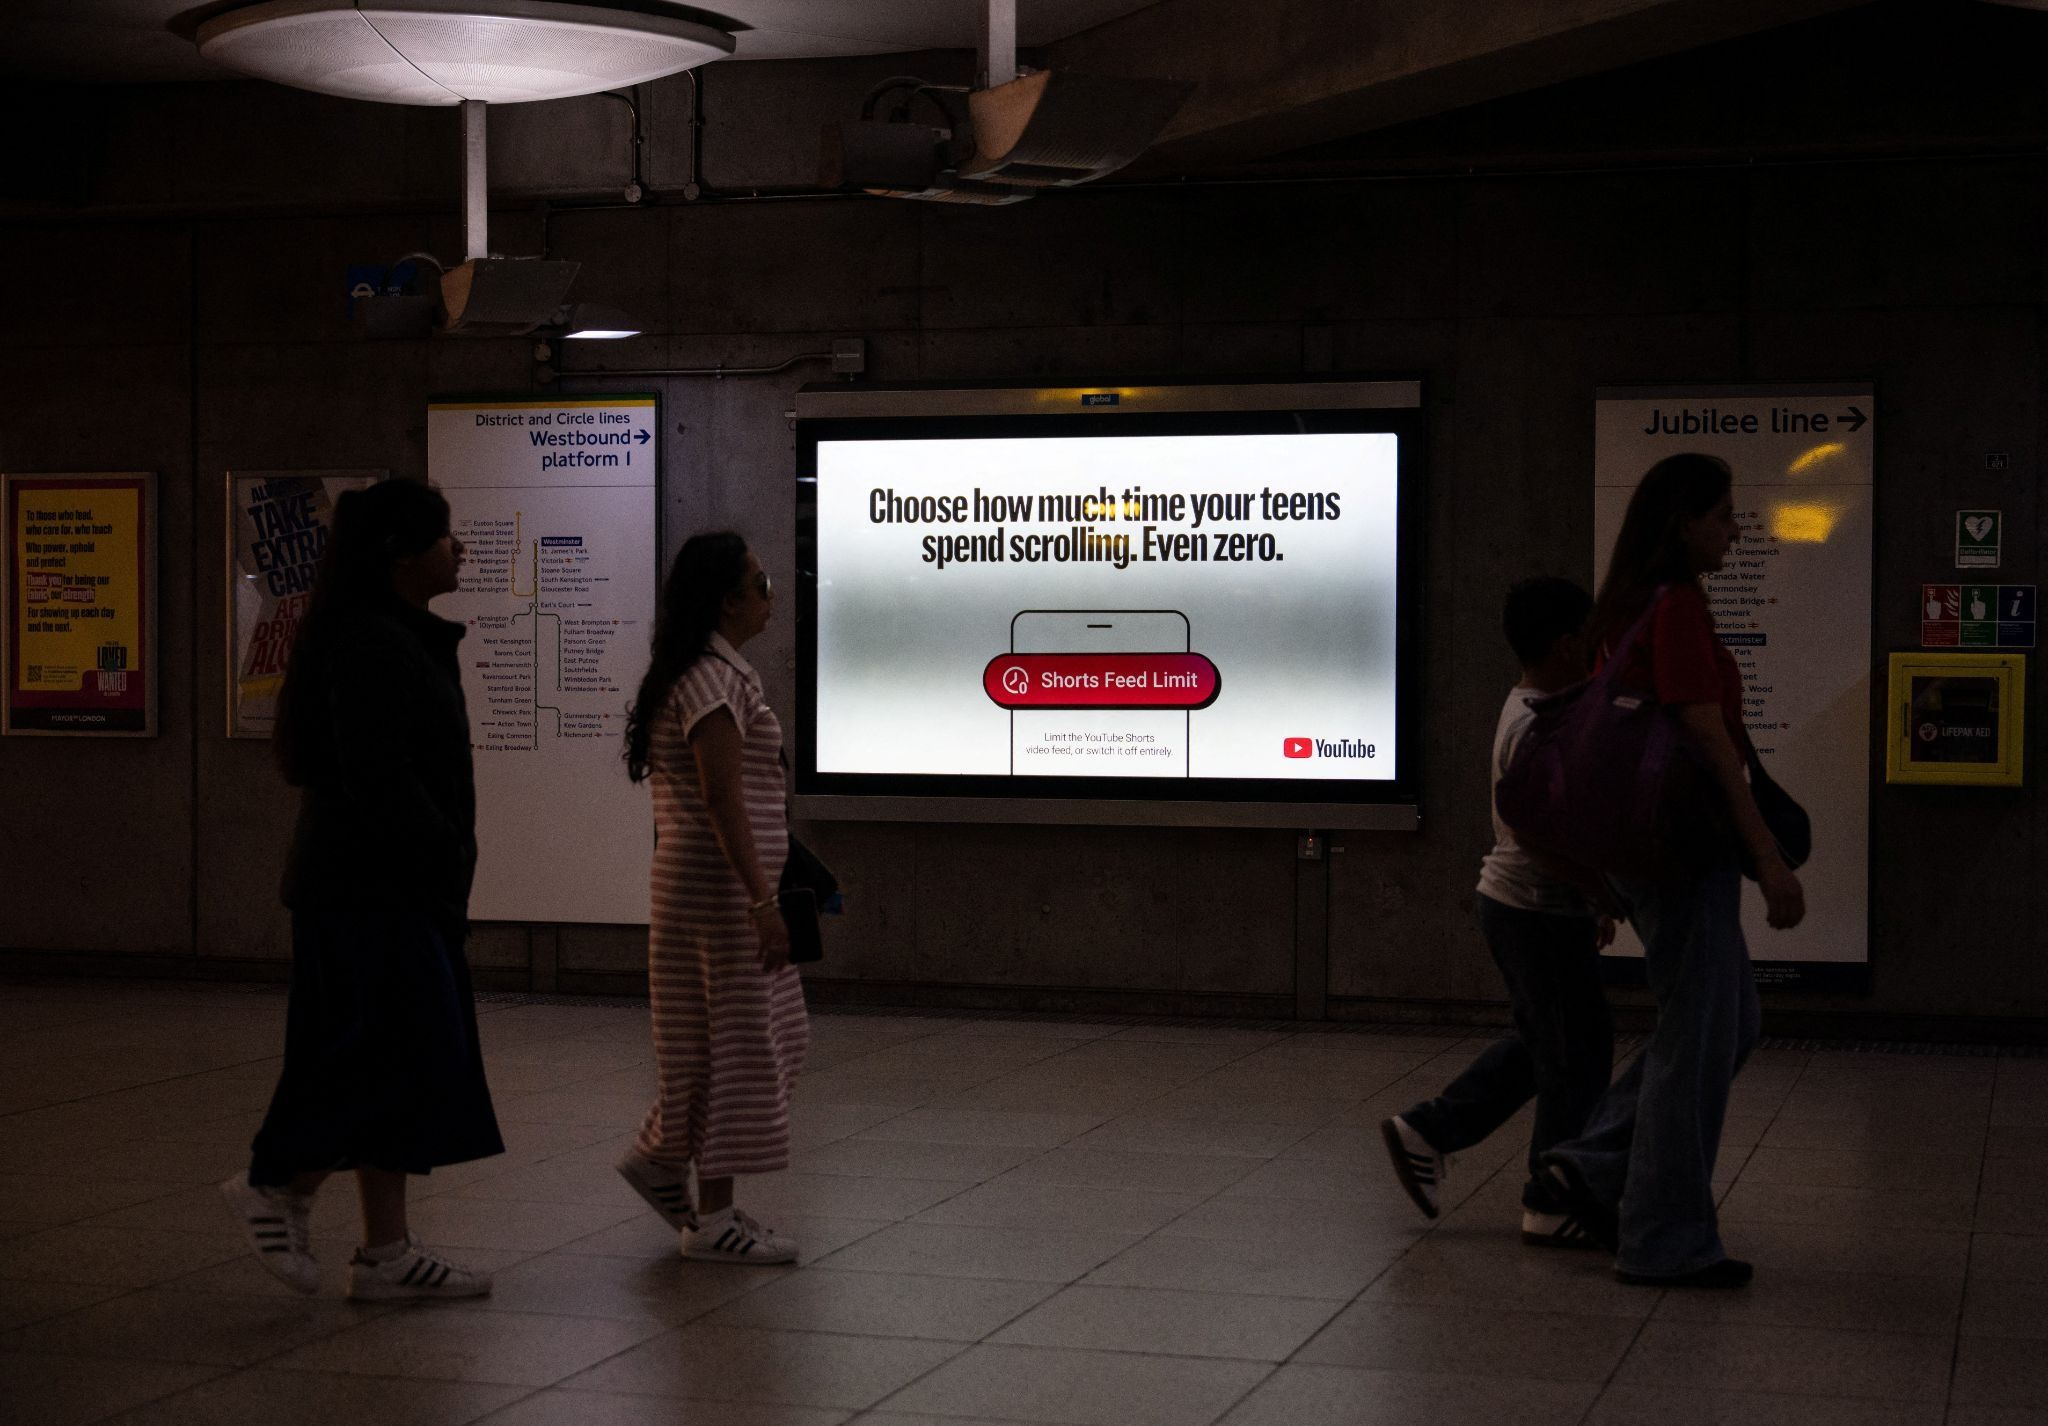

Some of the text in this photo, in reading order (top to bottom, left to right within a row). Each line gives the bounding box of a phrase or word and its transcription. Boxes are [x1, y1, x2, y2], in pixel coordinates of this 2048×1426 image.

[1089, 395, 1110, 404] global
[476, 412, 630, 426] District and Circle lines
[1644, 408, 1829, 434] Jubilee line
[530, 429, 631, 446] Westbound
[542, 451, 618, 471] platform
[870, 486, 1340, 528] Choose how much time your teens
[27, 510, 34, 520] To
[36, 510, 56, 520] those
[58, 510, 74, 520] who
[248, 492, 320, 539] TAKE
[26, 525, 41, 535] who
[43, 526, 59, 535] care
[75, 524, 90, 535] who
[92, 524, 112, 534] teach
[26, 542, 95, 553] Who uphold
[922, 526, 1283, 569] spend scrolling. Even zero.
[27, 557, 66, 568] and protect
[27, 575, 110, 587] Thank you for being our
[51, 592, 62, 600] our
[64, 589, 95, 601] strength
[1740, 598, 1766, 606] Bridge
[28, 607, 115, 619] For showing up each day
[28, 622, 41, 632] and
[42, 622, 53, 632] the
[97, 672, 127, 691] WANTED
[1042, 672, 1198, 688] Shorts Feed Limit
[1044, 733, 1155, 742] Limit the YouTube Shorts
[1942, 728, 1972, 737] LIFEPAK
[1976, 728, 1990, 737] AED
[1026, 745, 1050, 755] video
[1051, 745, 1072, 756] feed,
[1086, 745, 1115, 756] switch
[1117, 746, 1122, 756] it
[1125, 745, 1138, 756] off
[1316, 738, 1375, 758] YouTube
